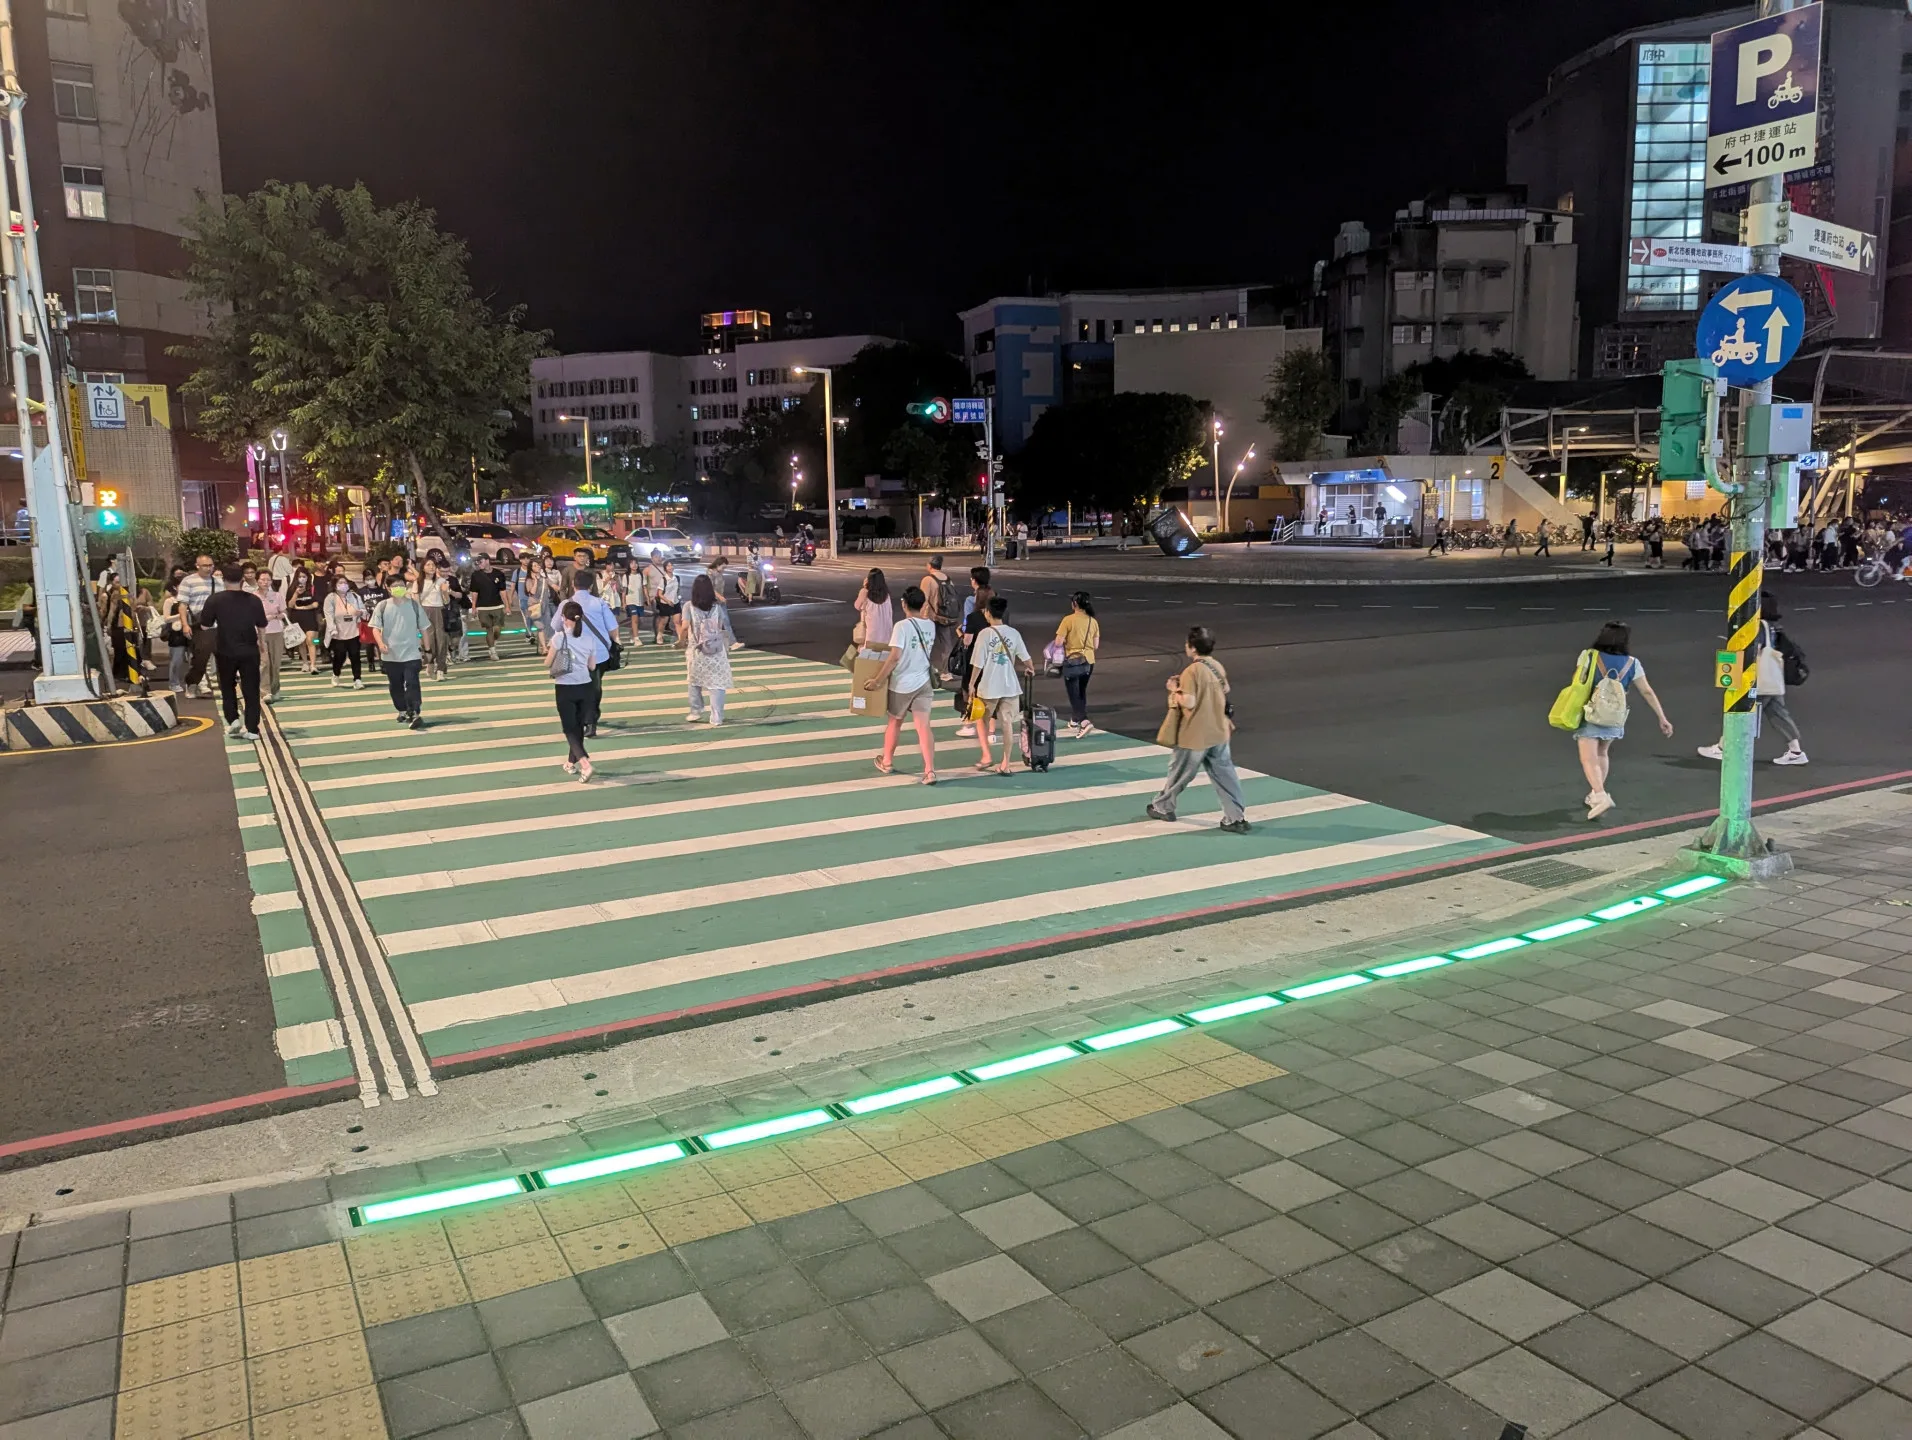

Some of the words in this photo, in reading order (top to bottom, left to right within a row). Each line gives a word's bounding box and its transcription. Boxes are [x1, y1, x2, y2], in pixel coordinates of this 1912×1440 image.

[1642, 48, 1666, 62] 府中
[1736, 33, 1793, 106] P
[1724, 121, 1797, 149] 府中捷運站
[1744, 142, 1785, 168] 100
[1789, 146, 1806, 159] m
[1814, 228, 1845, 248] 捷運府中站
[1668, 246, 1724, 259] 新北市板橋地政事務所
[134, 396, 153, 427] 1
[1490, 461, 1500, 480] 2
[99, 490, 118, 507] 32
[988, 635, 1014, 649] DICIES
